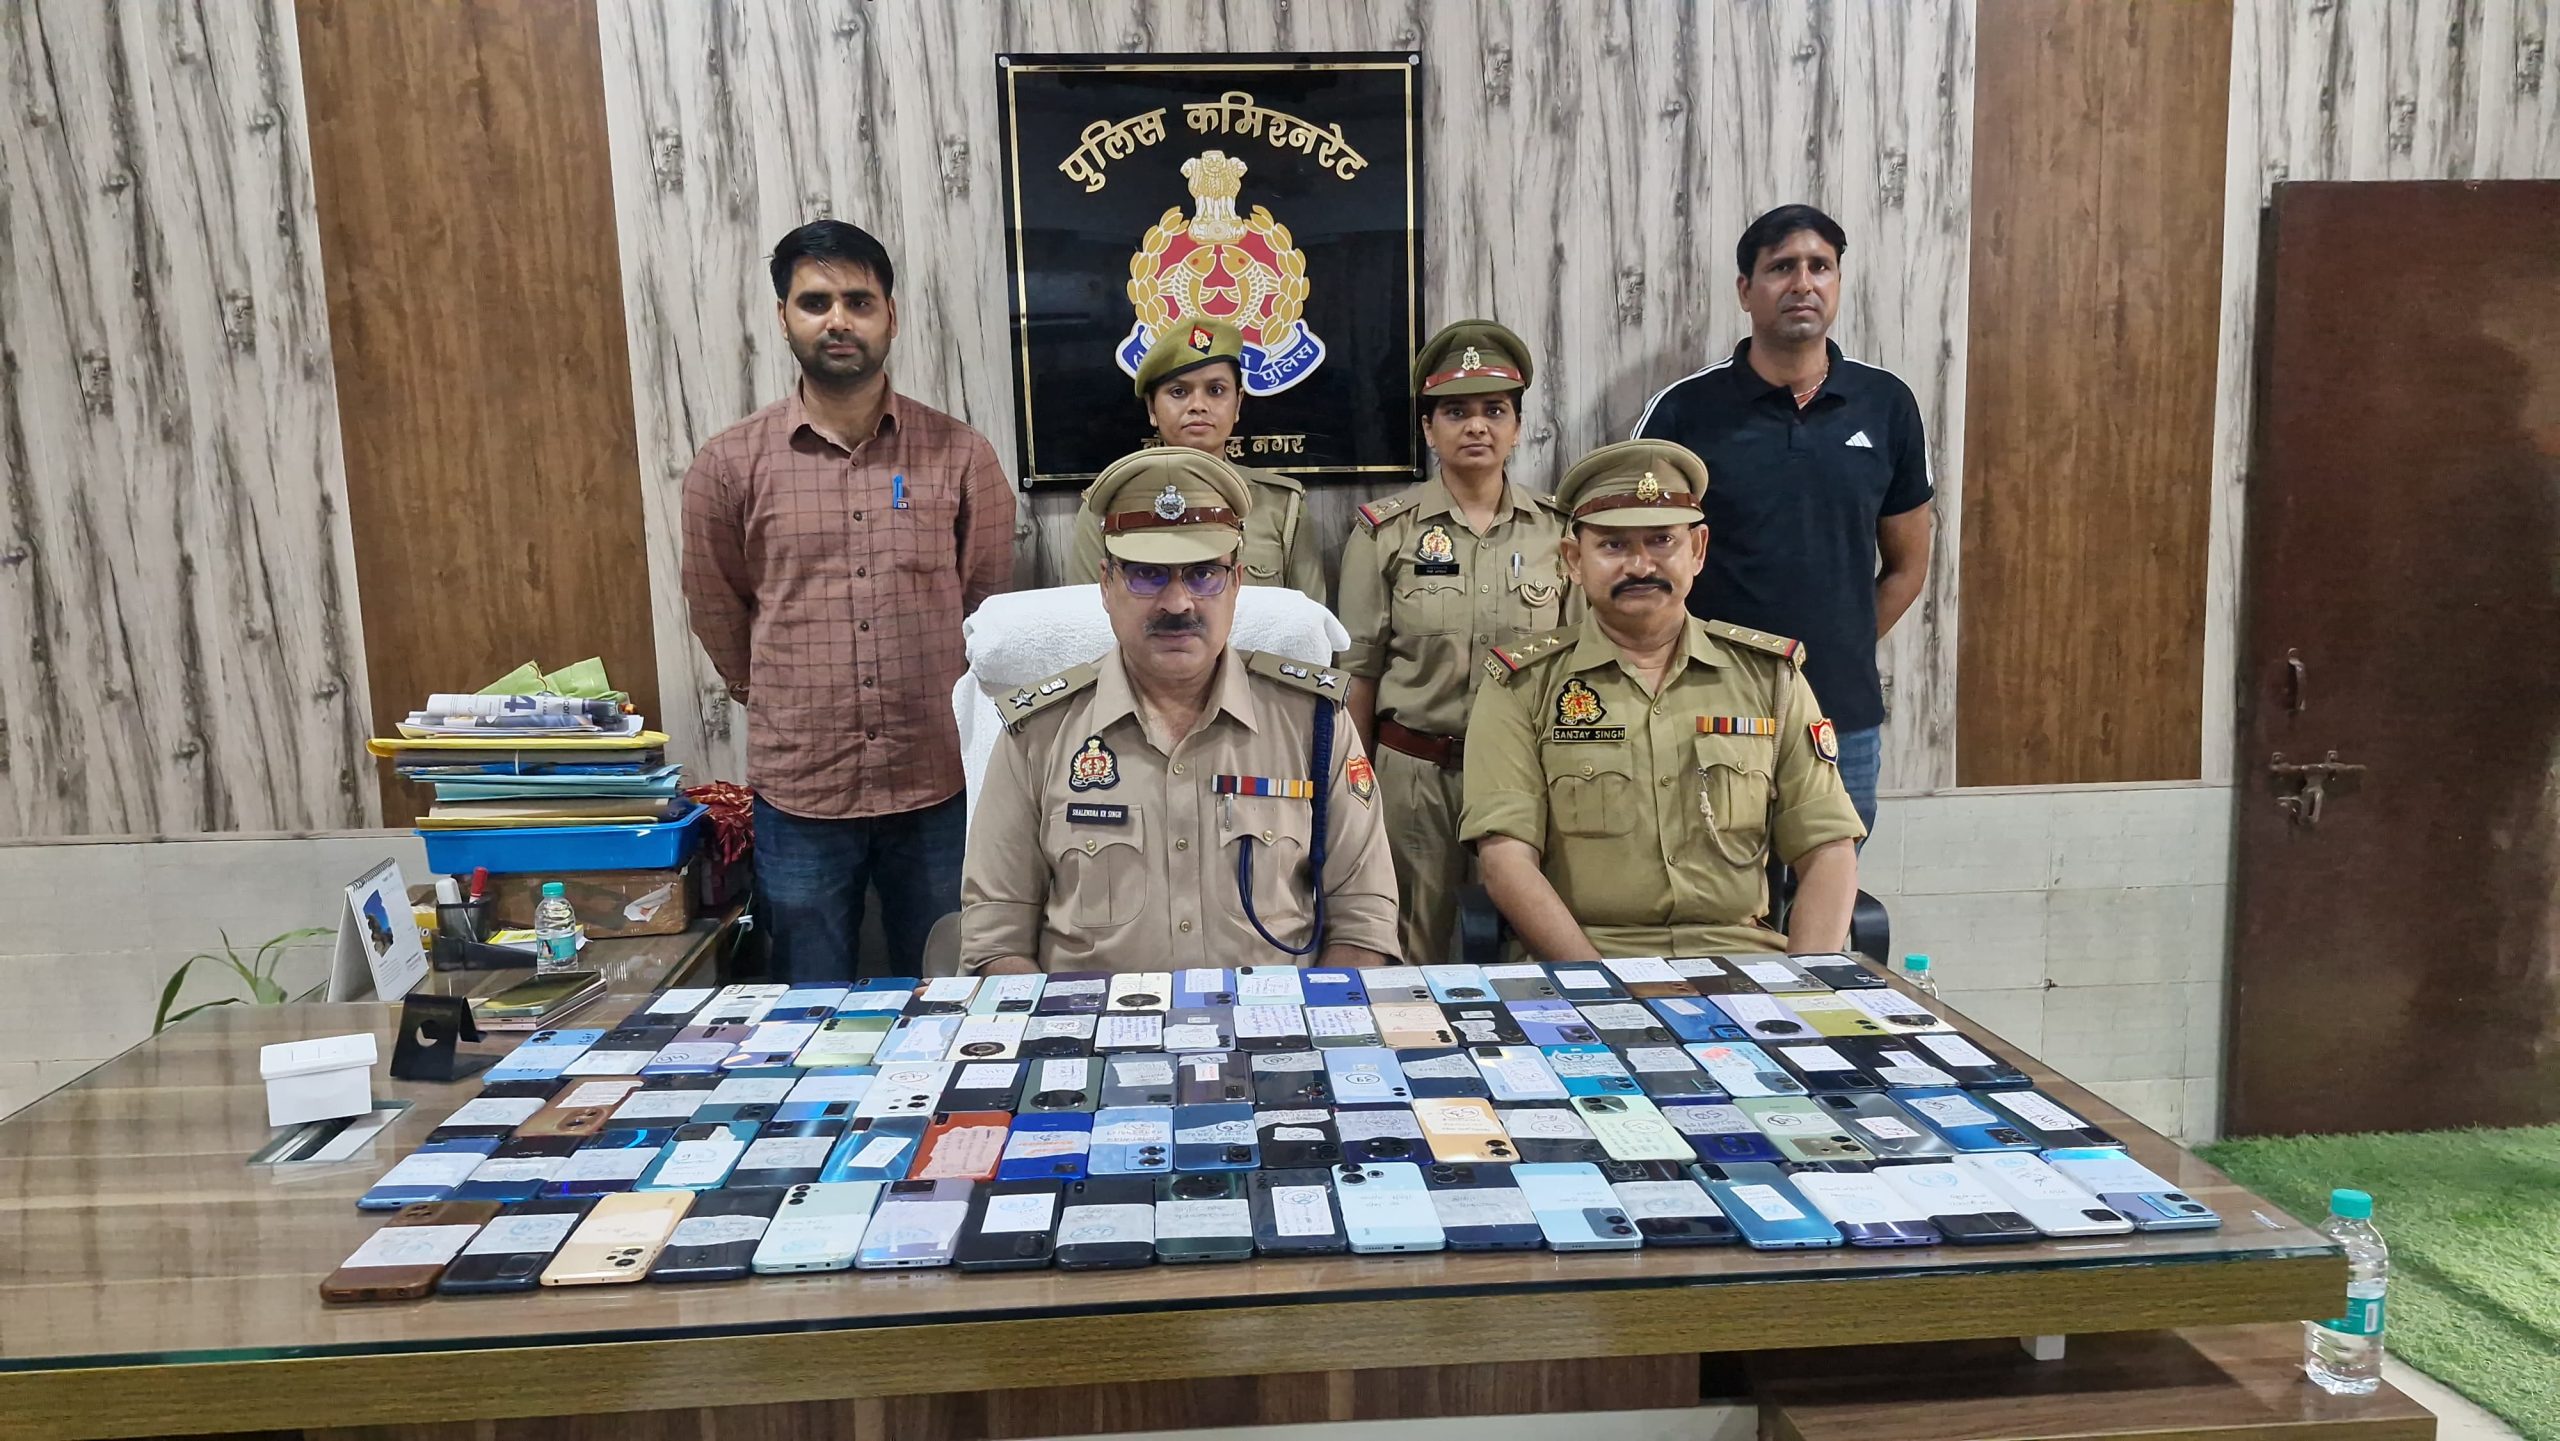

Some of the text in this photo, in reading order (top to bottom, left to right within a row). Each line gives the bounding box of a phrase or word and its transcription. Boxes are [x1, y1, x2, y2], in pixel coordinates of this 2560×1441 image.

[1058, 107, 1168, 193] पुलिस
[1258, 342, 1314, 388] पुलिस
[1250, 434, 1306, 454] नगर
[1554, 730, 1624, 739] SANJAY SINGH
